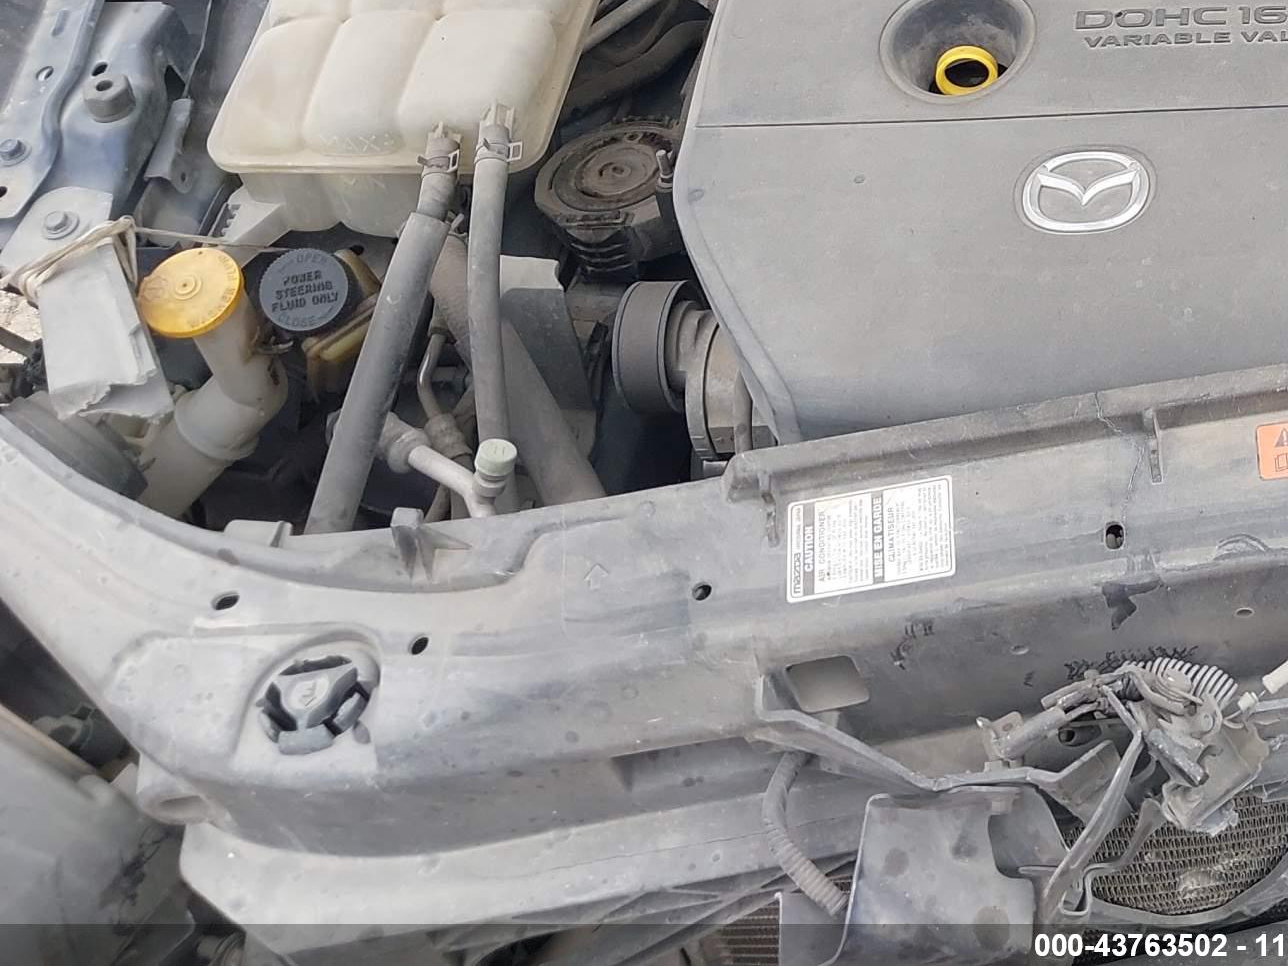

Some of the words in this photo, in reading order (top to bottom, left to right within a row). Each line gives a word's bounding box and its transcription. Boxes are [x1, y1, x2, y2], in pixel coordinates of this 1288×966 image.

[1075, 6, 1228, 30] DOHC
[1083, 30, 1231, 48] VARIABLE
[275, 280, 334, 300] STEERING
[283, 270, 323, 286] POWER
[271, 297, 307, 313] FLUID
[311, 291, 339, 306] ONLY
[872, 497, 882, 533] GARDE
[818, 511, 826, 564] CONDITIONER
[873, 535, 883, 550] EN
[887, 506, 896, 562] CLIMATISEUR
[804, 526, 814, 572] CAUTION
[793, 552, 802, 594] mazda
[818, 568, 826, 582] AIR
[873, 551, 883, 578] MISE
